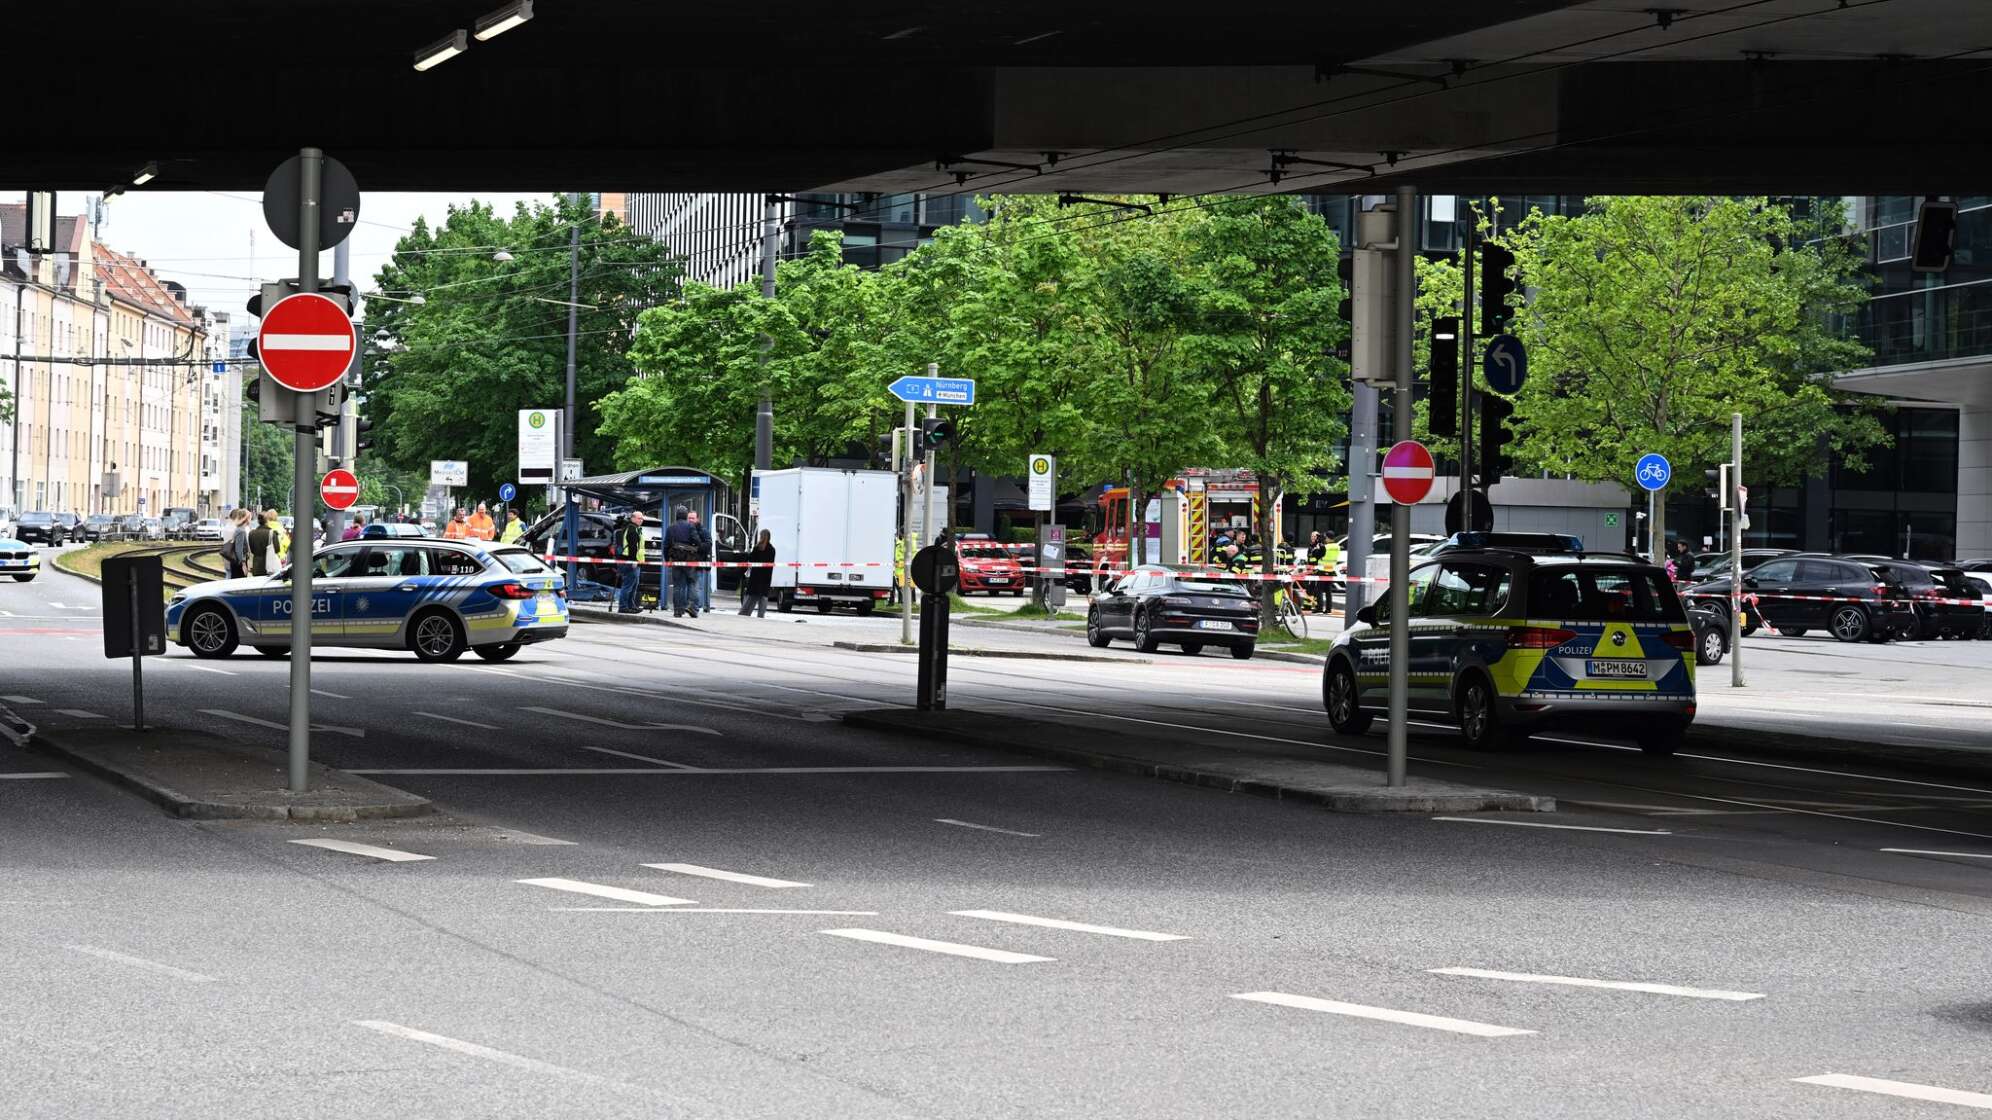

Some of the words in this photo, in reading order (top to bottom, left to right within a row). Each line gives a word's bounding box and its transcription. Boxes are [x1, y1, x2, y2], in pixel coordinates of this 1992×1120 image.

[936, 381, 968, 390] Nürnberg
[460, 565, 474, 574] 110
[273, 598, 331, 614] POZEI
[1558, 646, 1592, 654] POLIZEI
[1594, 662, 1600, 674] M
[1607, 662, 1619, 674] PM
[1621, 662, 1645, 674] 8642
